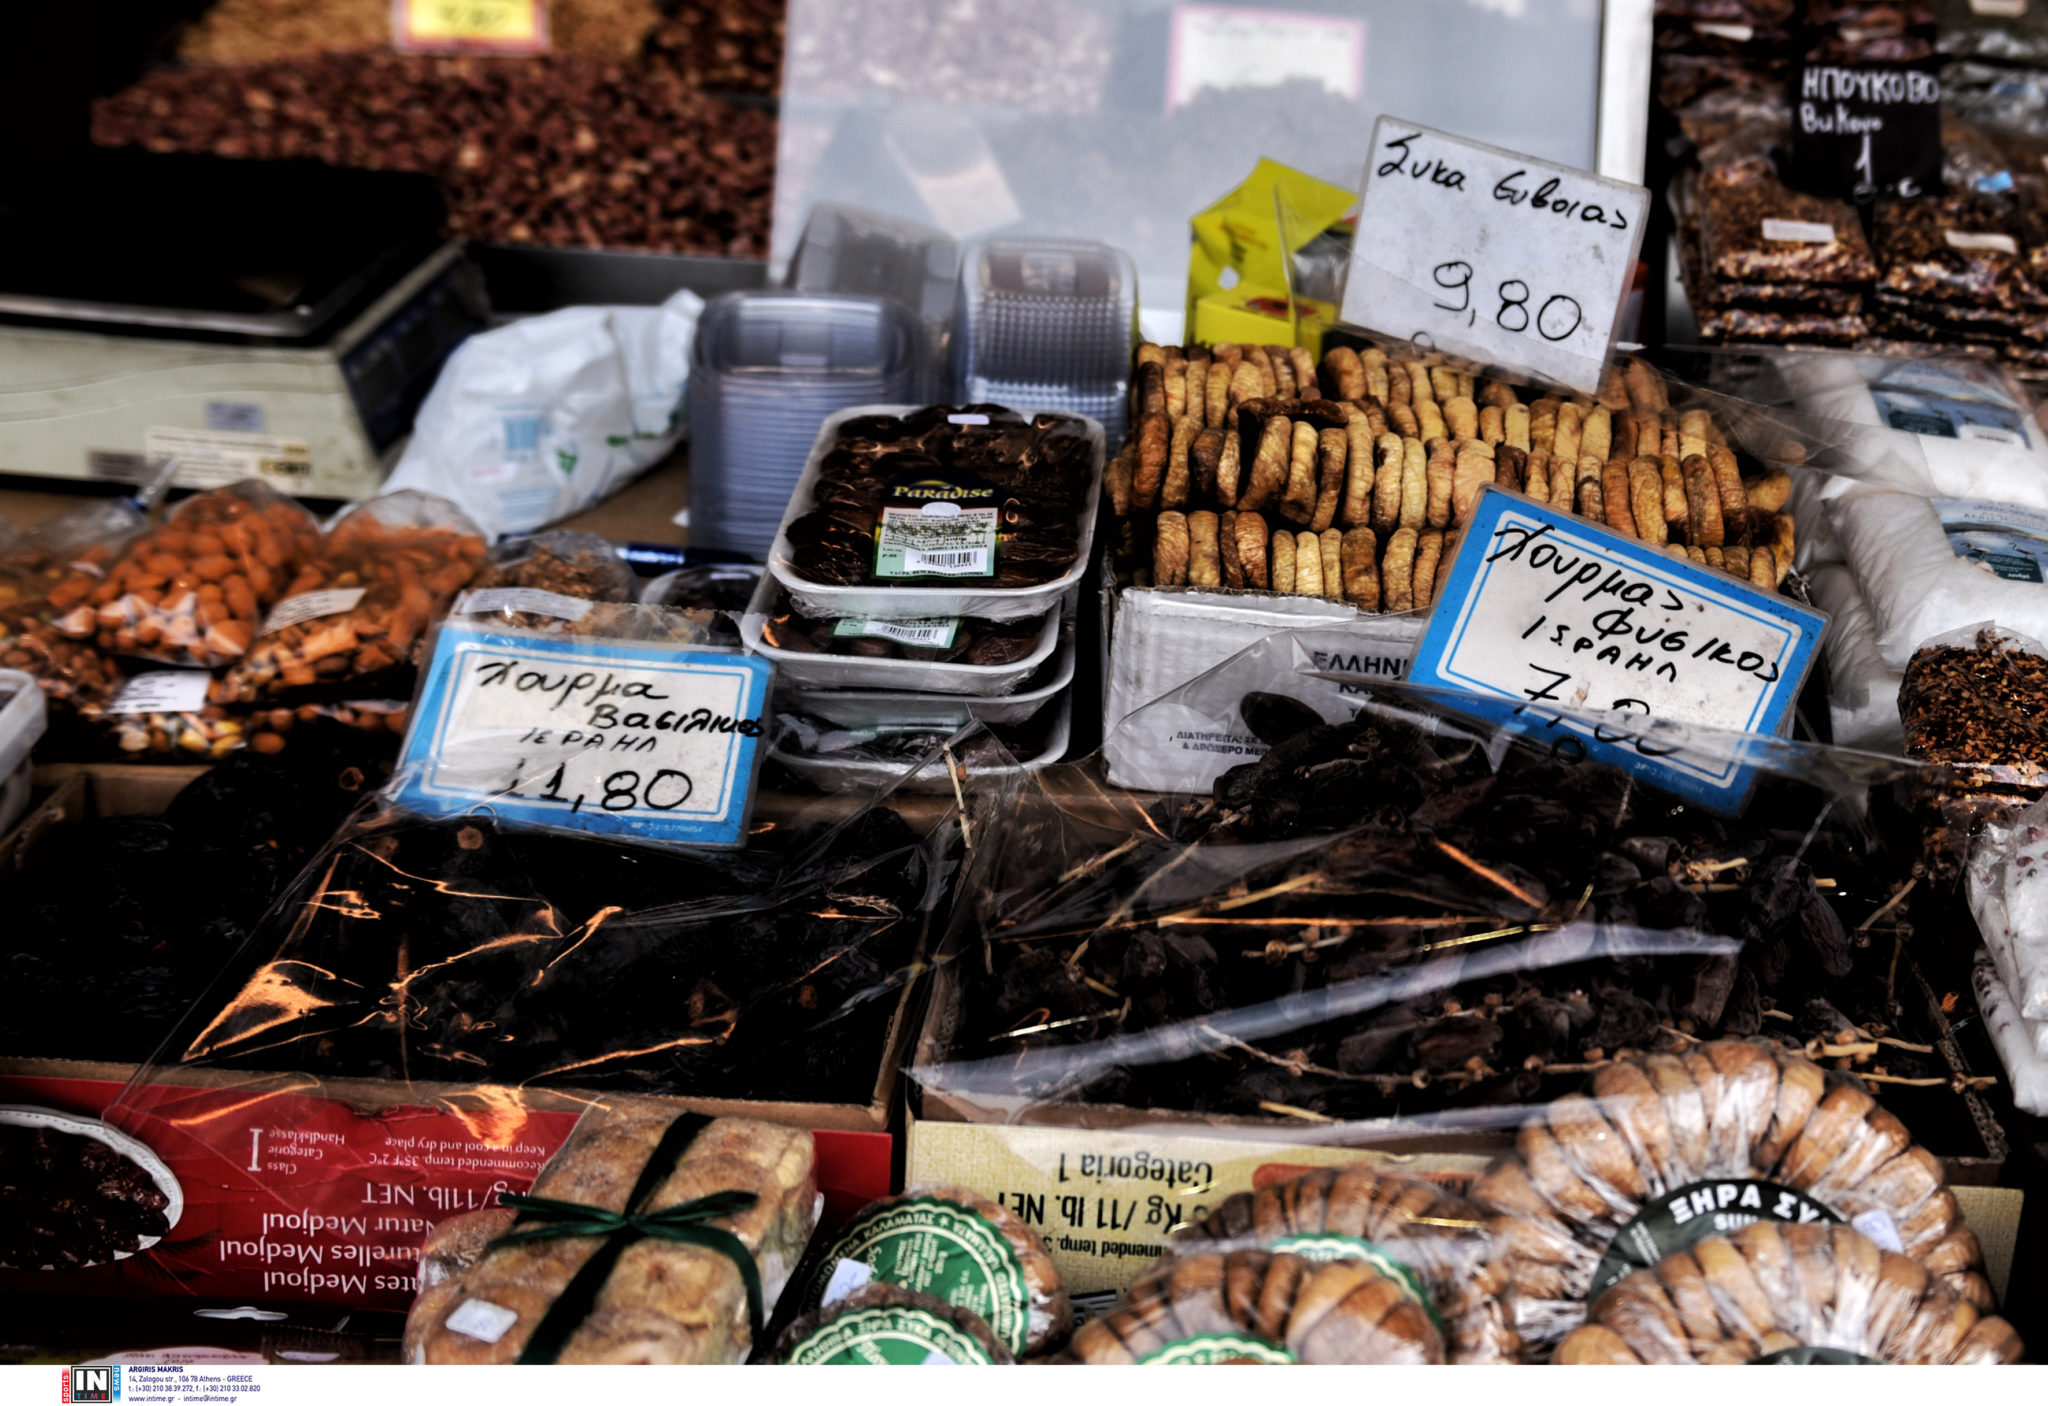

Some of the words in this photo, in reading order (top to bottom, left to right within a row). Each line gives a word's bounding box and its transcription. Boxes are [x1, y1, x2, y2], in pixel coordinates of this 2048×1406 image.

[1433, 261, 1582, 342] 9,80
[893, 485, 994, 500] Paradise
[1314, 651, 1408, 676] ΕΛΛΗΝΙ
[268, 1129, 345, 1145] Handlsklasse
[385, 1136, 415, 1150] place
[417, 1137, 437, 1151] dry
[439, 1140, 462, 1152] and
[267, 1143, 323, 1160] Categorie
[464, 1141, 489, 1153] cool
[502, 1145, 512, 1155] in
[515, 1142, 545, 1156] Keep
[267, 1162, 296, 1173] Class
[422, 1155, 455, 1168] temp.
[458, 1156, 546, 1173] Recommended
[1058, 1153, 1069, 1182] 1
[1082, 1151, 1212, 1193] Categoria
[361, 1182, 414, 1205] NET
[1055, 1196, 1085, 1227] lb.
[1668, 1184, 1763, 1225] ΞΗΡΑ
[1772, 1192, 1831, 1226] ΣΥ
[262, 1208, 366, 1237] Medjoul
[1145, 1195, 1182, 1234] Kg
[220, 1237, 323, 1264] Medjoul
[1056, 1235, 1096, 1256] temp.
[1101, 1241, 1163, 1259] mended
[331, 1245, 420, 1266] turelles
[264, 1266, 366, 1295] Medjoul
[375, 1275, 420, 1292] ates
